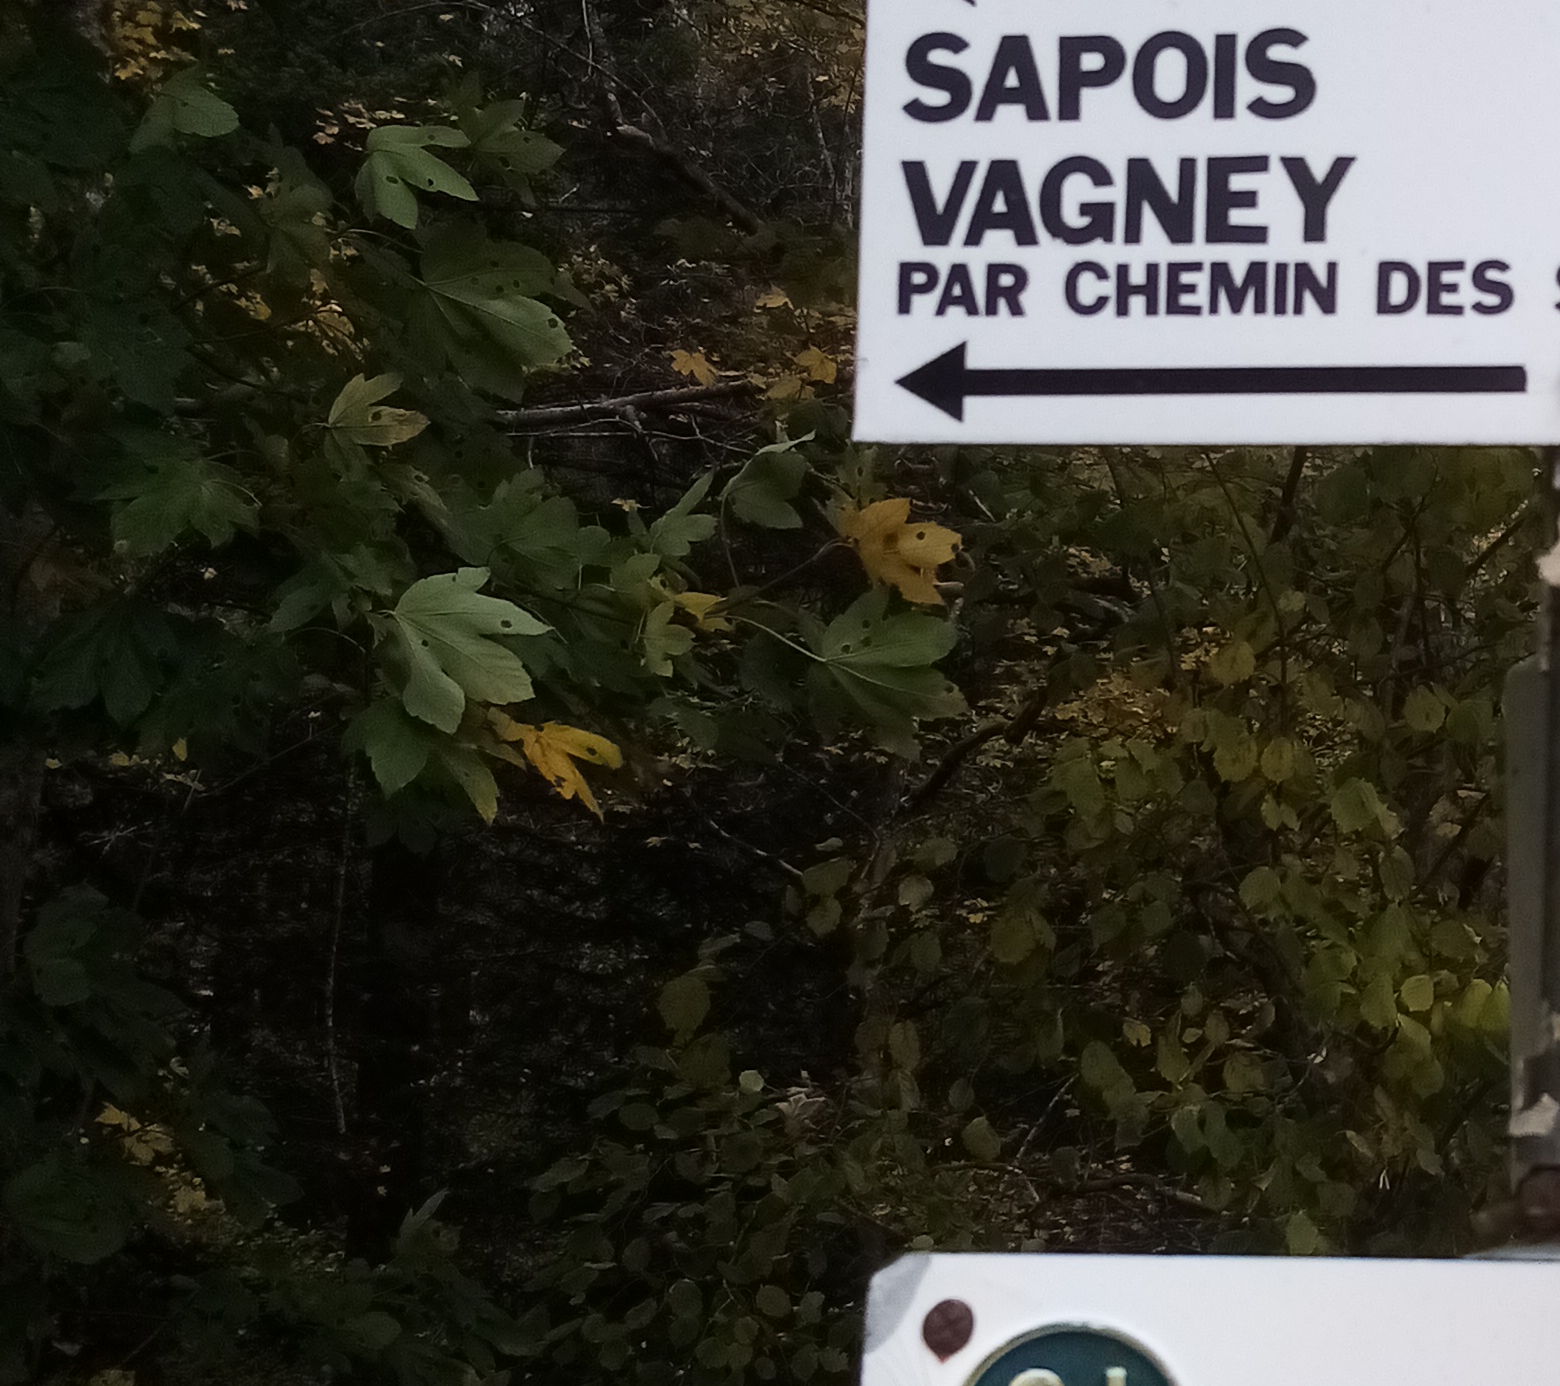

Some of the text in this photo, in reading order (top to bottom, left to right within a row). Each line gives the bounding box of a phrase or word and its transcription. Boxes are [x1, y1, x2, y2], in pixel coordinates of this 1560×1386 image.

[901, 26, 1318, 125] SAPOIS
[899, 153, 1357, 248] VAGNEY
[896, 260, 1030, 318] PAR
[1063, 259, 1339, 319] CHEMIN
[1375, 258, 1515, 317] DES
